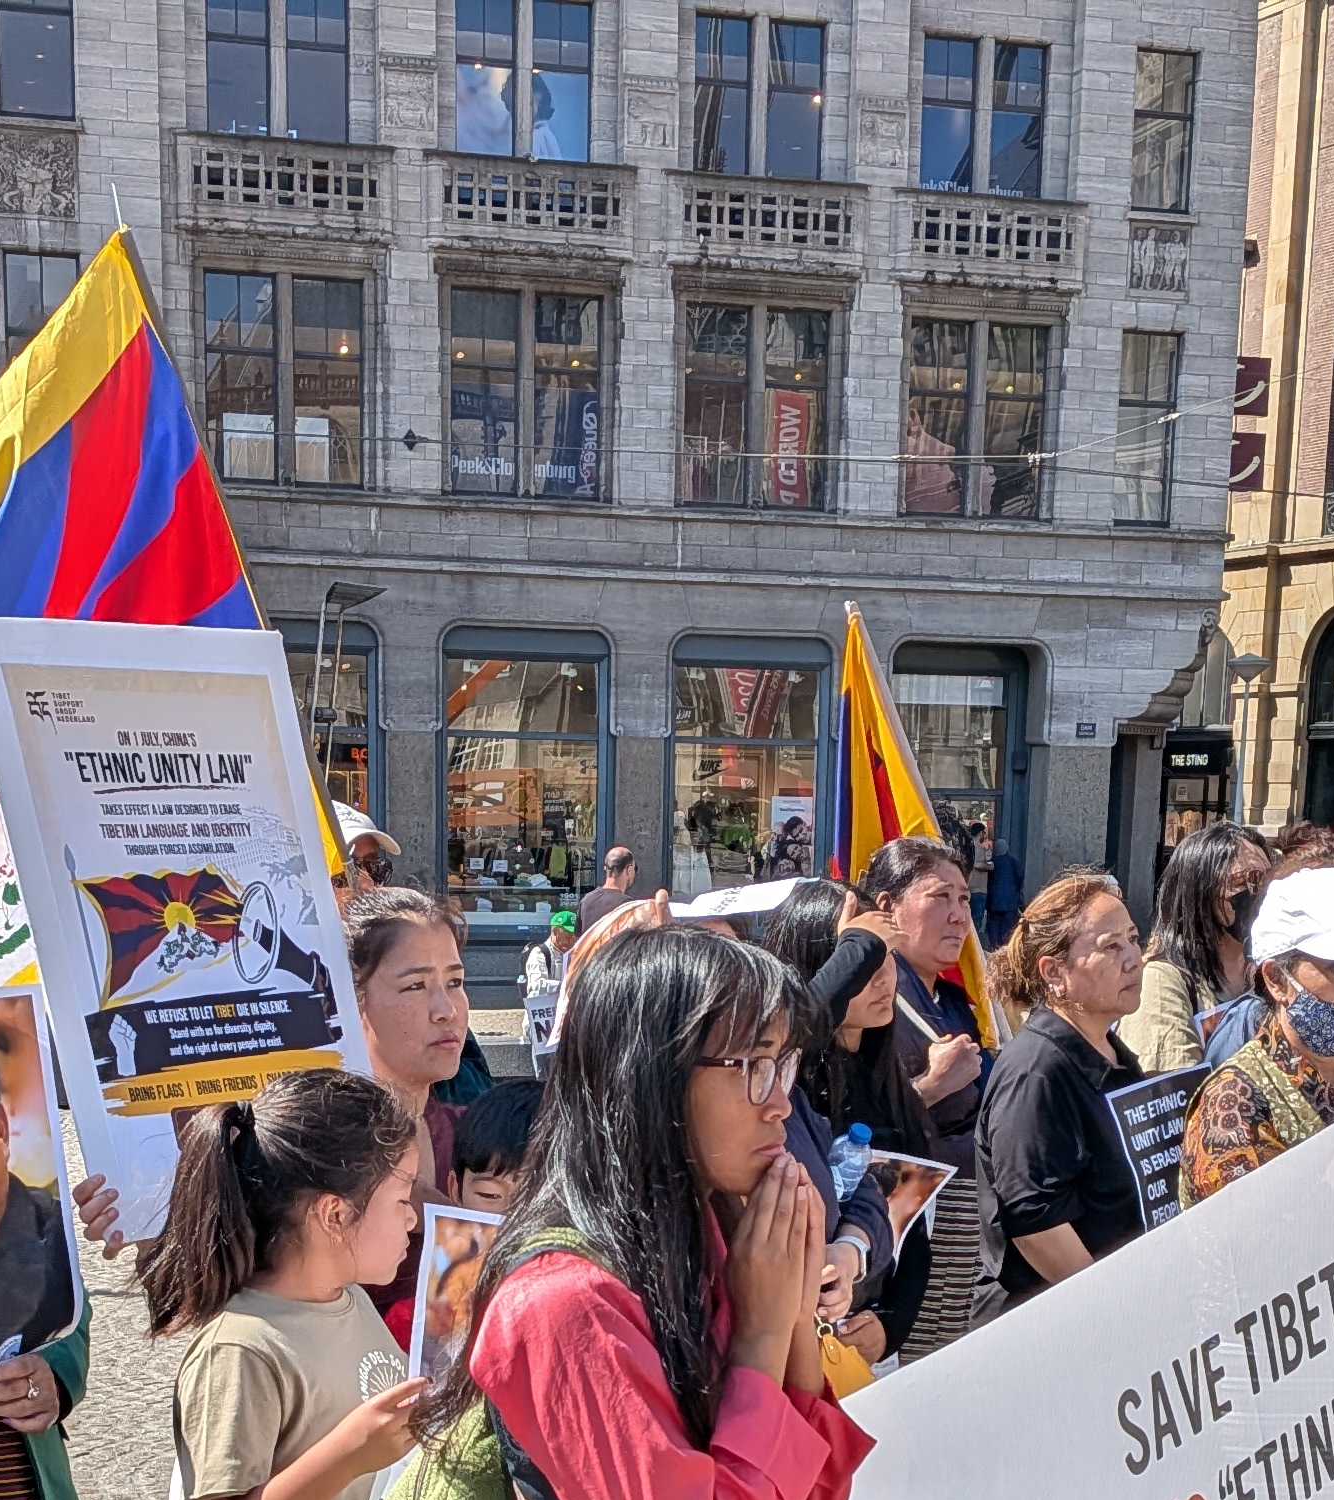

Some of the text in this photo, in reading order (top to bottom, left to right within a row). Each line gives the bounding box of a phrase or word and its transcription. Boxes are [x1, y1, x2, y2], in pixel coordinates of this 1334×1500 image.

[117, 731, 132, 747] ON
[133, 731, 138, 747] 1
[141, 731, 162, 749] JULY,
[64, 752, 253, 784] "ETHNIC UNITY LAW"
[698, 759, 722, 773] NIKE
[1171, 754, 1209, 767] THE STING
[100, 803, 242, 816] TAKES EFFECT A LAW DESIGNED TO ERASE
[99, 823, 252, 839] TIBETAN LANGUAGE AND IDENTITY
[124, 844, 158, 856] THROUGH
[159, 843, 187, 855] FORCED
[144, 999, 292, 1025] WE REFUSE TO LET TIBET DIE IN SILENCE.
[170, 1044, 182, 1056] and
[182, 1043, 194, 1055] the
[194, 1042, 211, 1056] right
[211, 1042, 218, 1052] of
[219, 1041, 237, 1053] every
[237, 1038, 259, 1051] people
[259, 1038, 267, 1048] to
[128, 1086, 156, 1102] BRING
[157, 1082, 185, 1100] FLAGS
[195, 1080, 222, 1096] BRING
[223, 1075, 258, 1092] FRIENDS
[1124, 1089, 1187, 1127] THE ETHNIC
[1131, 1116, 1183, 1152] UNITY LAW
[1140, 1156, 1152, 1177] IS
[1147, 1178, 1168, 1201] OUR
[367, 1350, 389, 1365] DEL
[1117, 1333, 1233, 1476] SAVE
